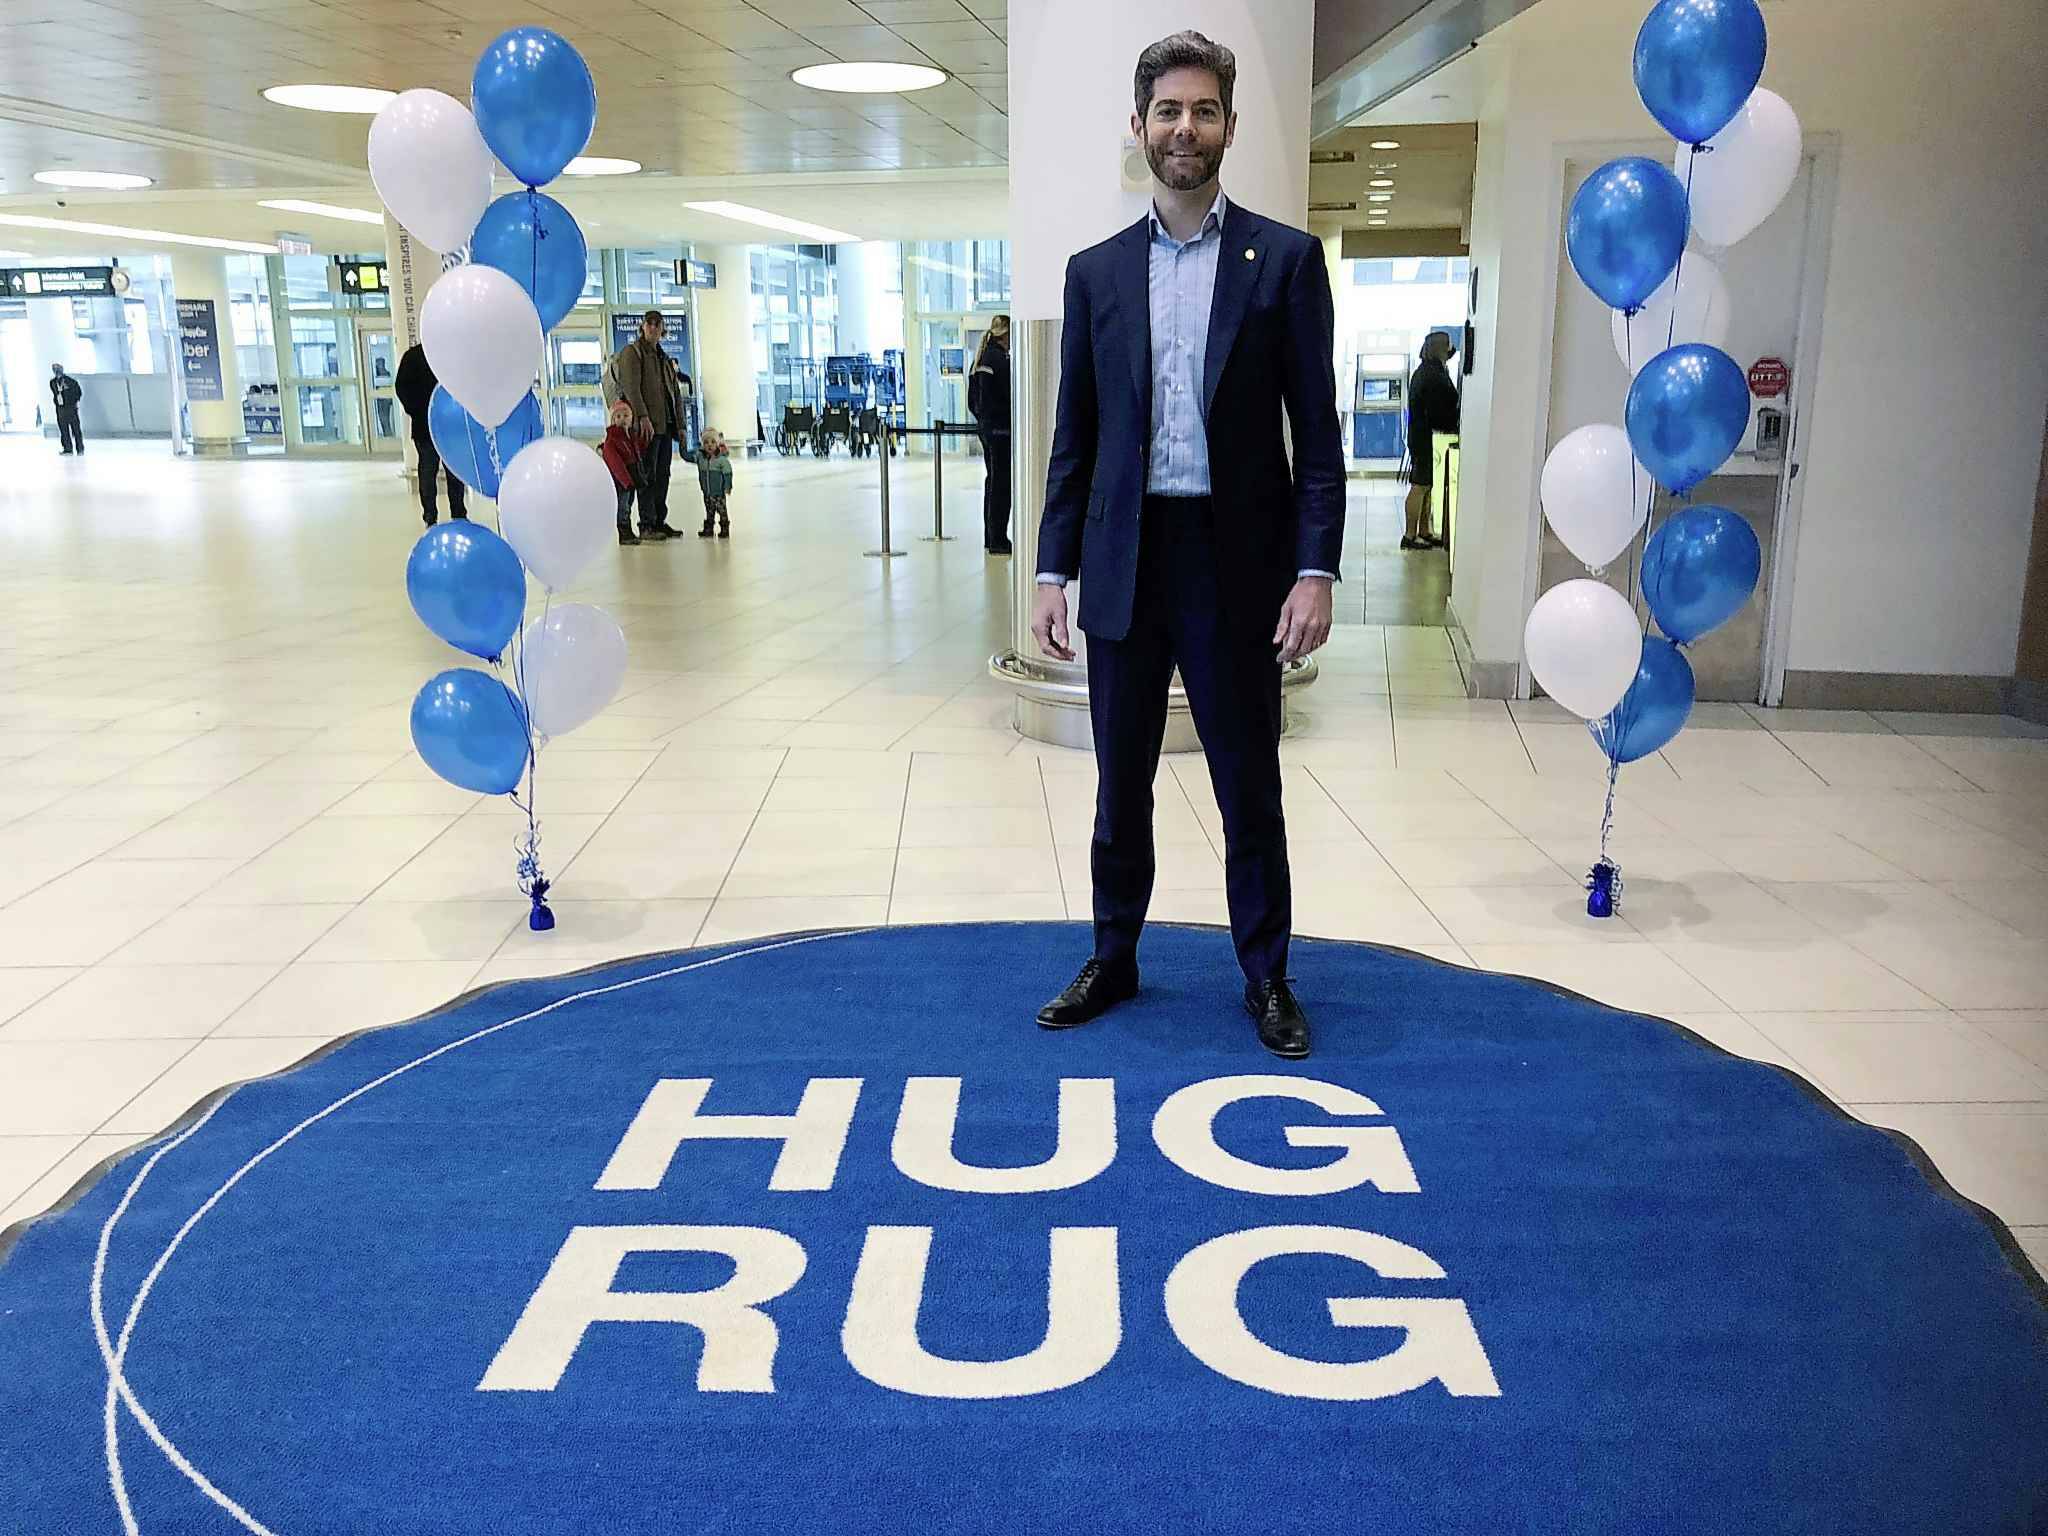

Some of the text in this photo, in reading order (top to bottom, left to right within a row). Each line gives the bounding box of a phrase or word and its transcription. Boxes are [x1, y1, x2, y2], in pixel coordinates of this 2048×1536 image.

[403, 277, 413, 294] YOU
[405, 296, 414, 313] CAN
[594, 1075, 1421, 1196] HUG
[476, 1225, 1502, 1402] RUG
